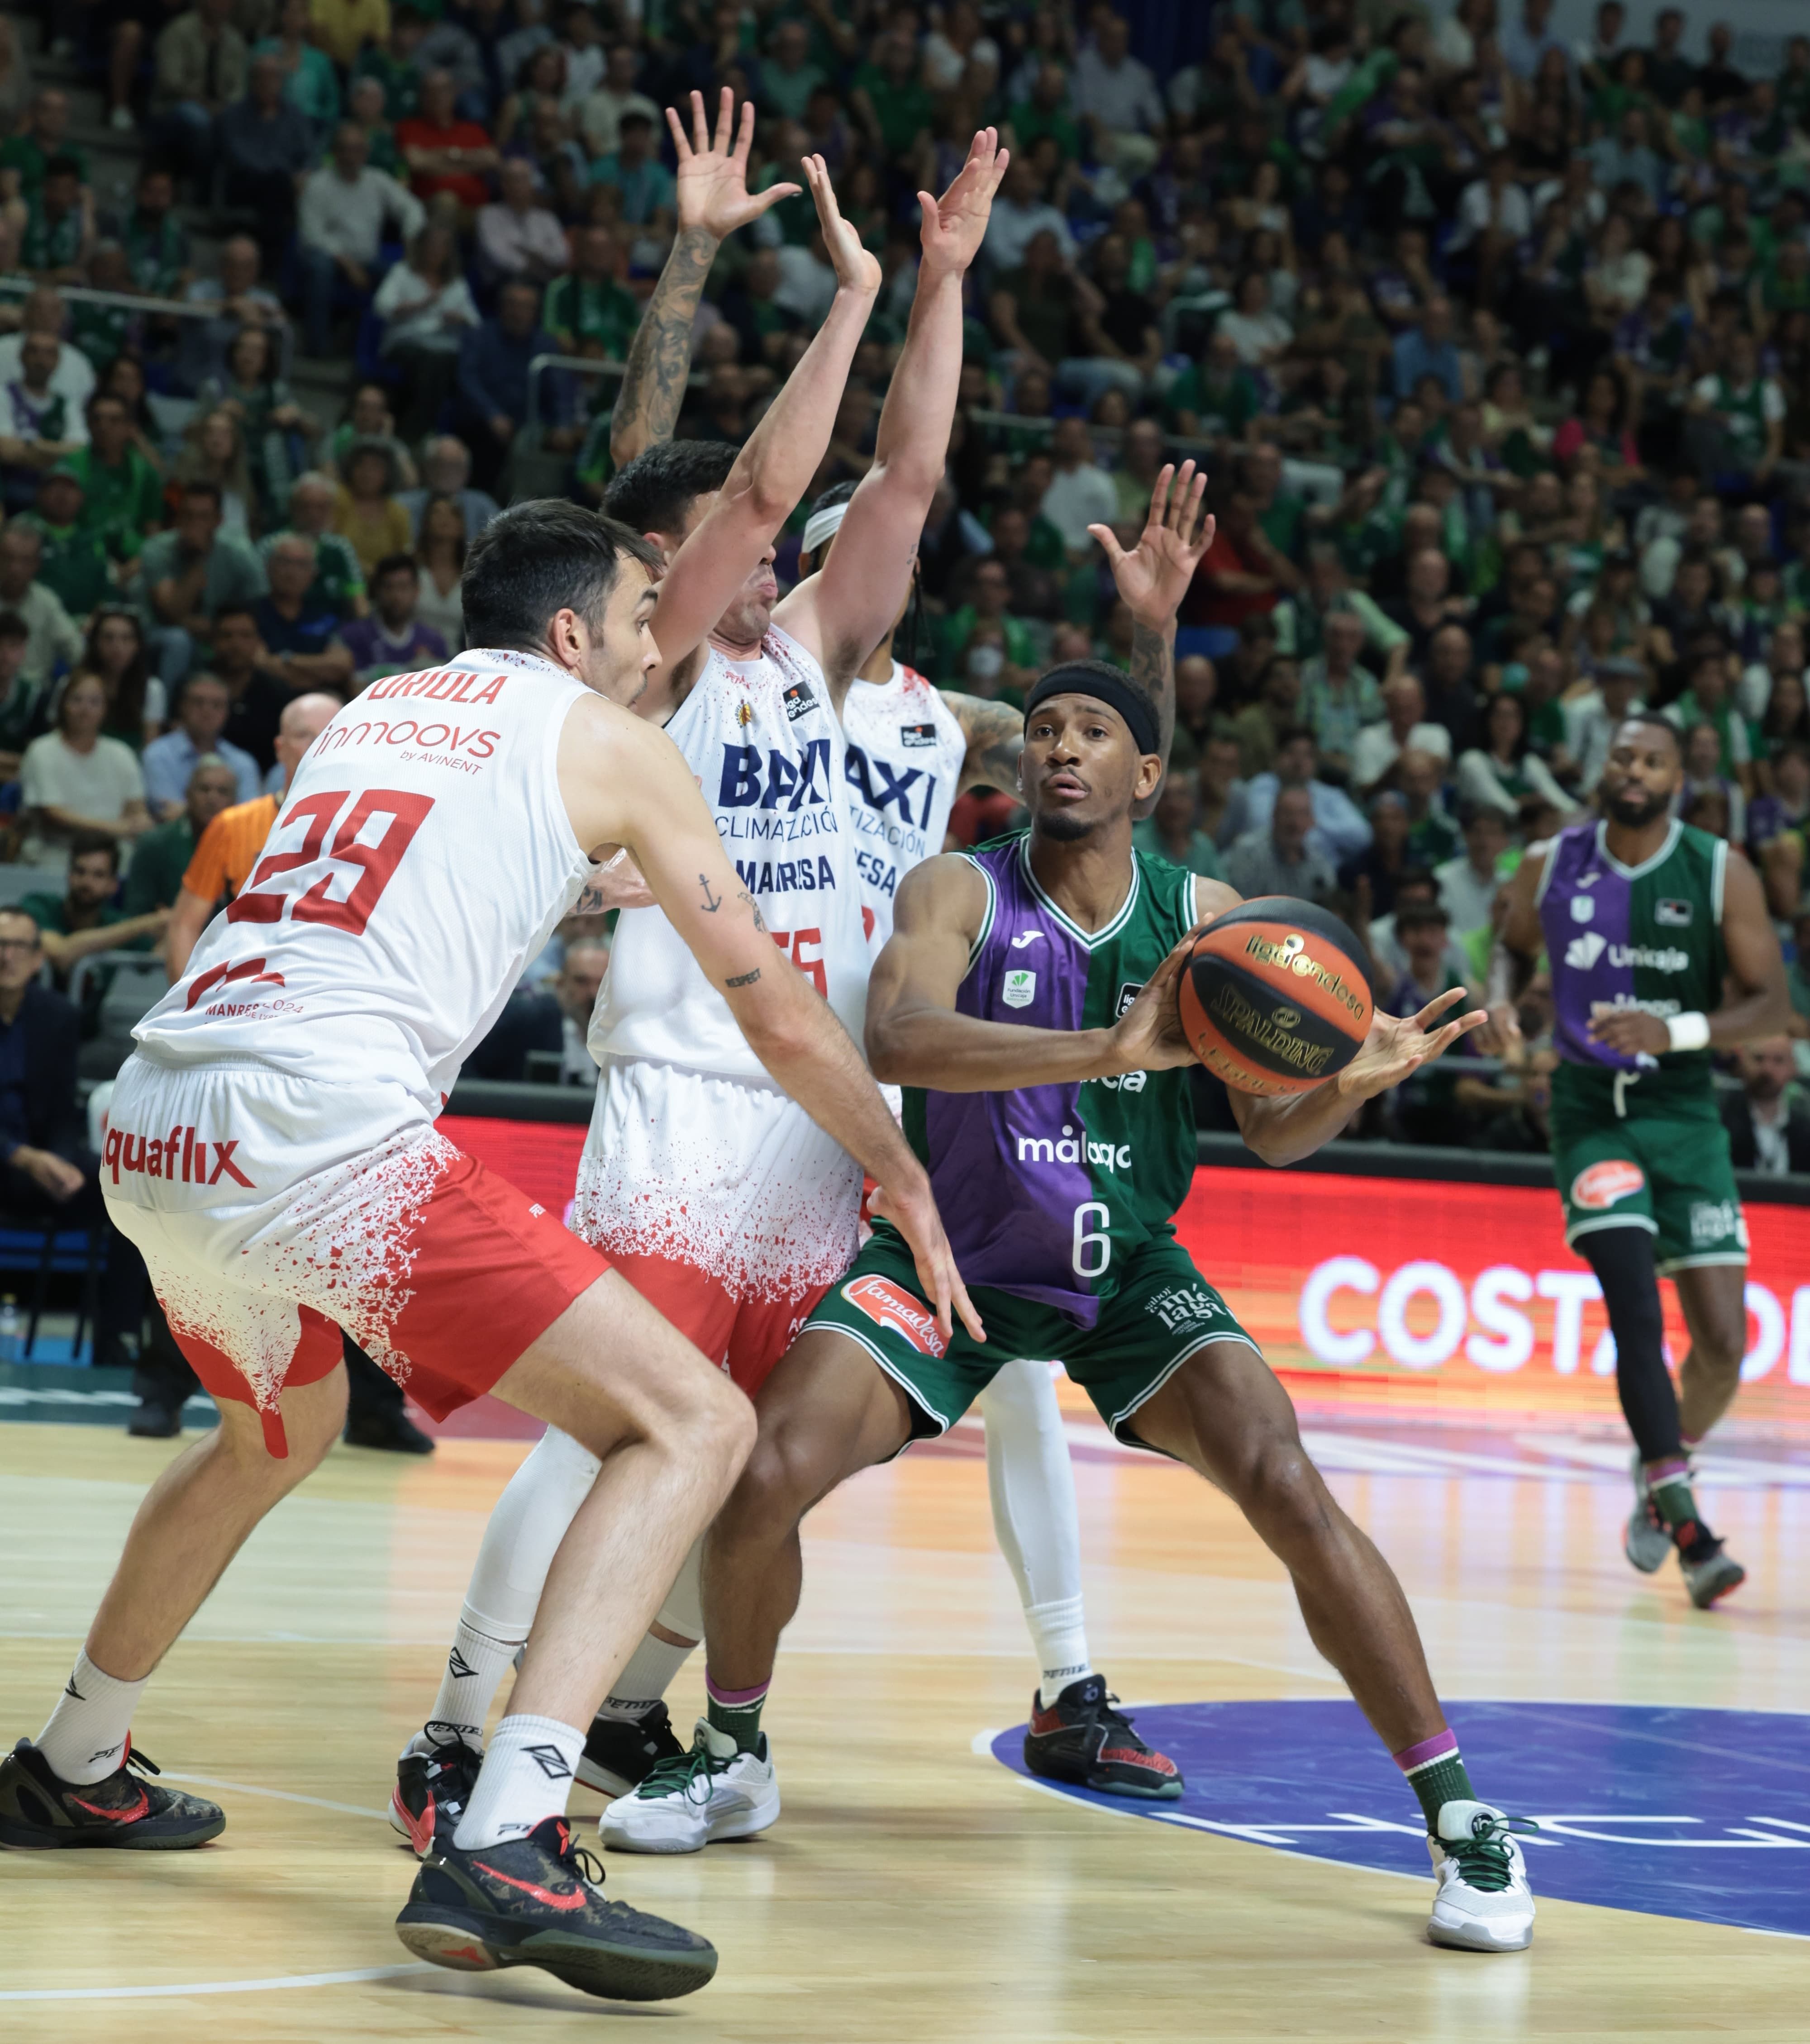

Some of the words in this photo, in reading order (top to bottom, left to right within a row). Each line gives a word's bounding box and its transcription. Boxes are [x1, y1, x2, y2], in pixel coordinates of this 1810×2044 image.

[400, 750, 417, 761] by
[417, 753, 482, 775] AVINENT
[718, 739, 832, 812] BAXI
[844, 743, 936, 832] AXI
[1123, 994, 1135, 1006] lig
[102, 1125, 257, 1189] quaflix
[1072, 1202, 1111, 1277] 6
[1298, 1254, 1673, 1377] COST
